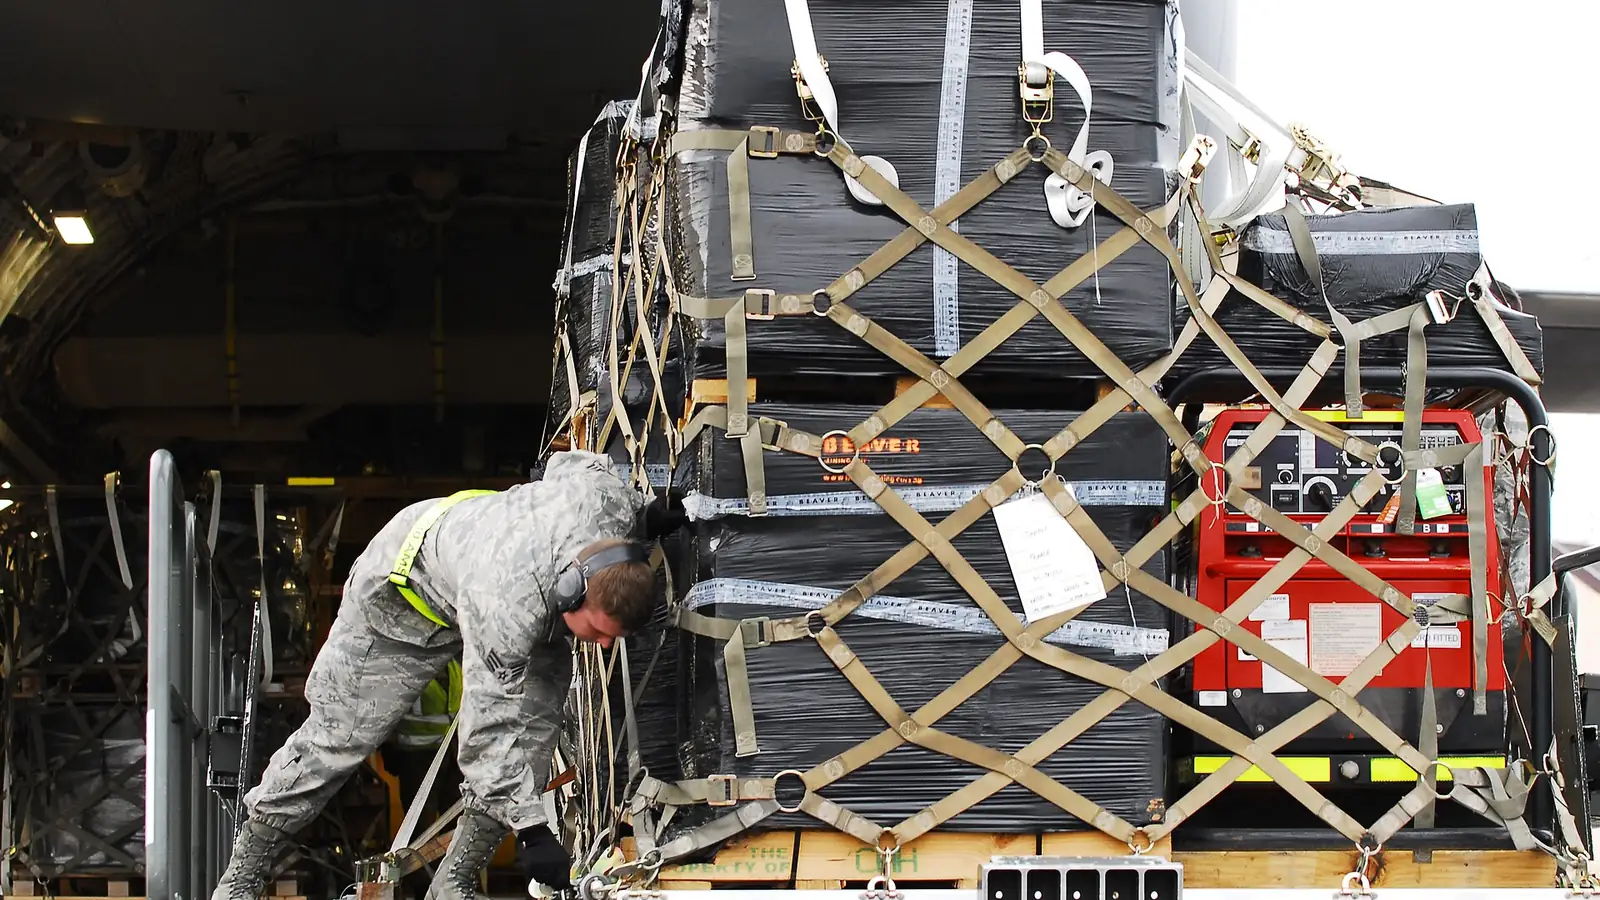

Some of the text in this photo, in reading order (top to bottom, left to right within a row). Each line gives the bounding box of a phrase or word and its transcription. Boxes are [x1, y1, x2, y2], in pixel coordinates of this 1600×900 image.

[822, 437, 920, 453] BEAVER
[738, 500, 777, 508] BEER
[1423, 524, 1431, 533] B
[918, 606, 957, 615] BEAVER
[1433, 634, 1459, 642] FITTED
[751, 847, 788, 858] THE
[765, 861, 789, 873] OF
